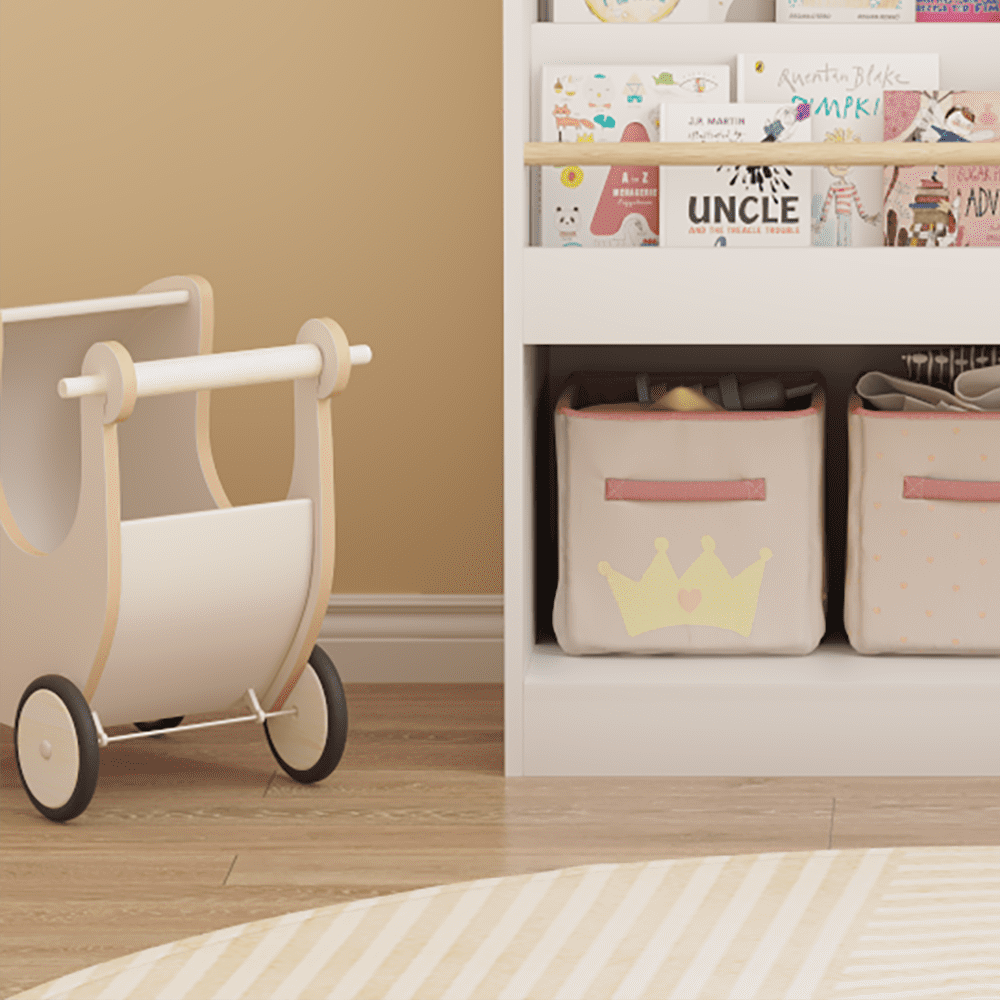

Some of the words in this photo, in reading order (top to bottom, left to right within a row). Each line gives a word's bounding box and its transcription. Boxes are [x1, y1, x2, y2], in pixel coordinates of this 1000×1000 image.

[846, 63, 911, 92] Blake
[622, 172, 629, 184] A
[642, 172, 649, 184] Z
[688, 195, 800, 225] UNCLE
